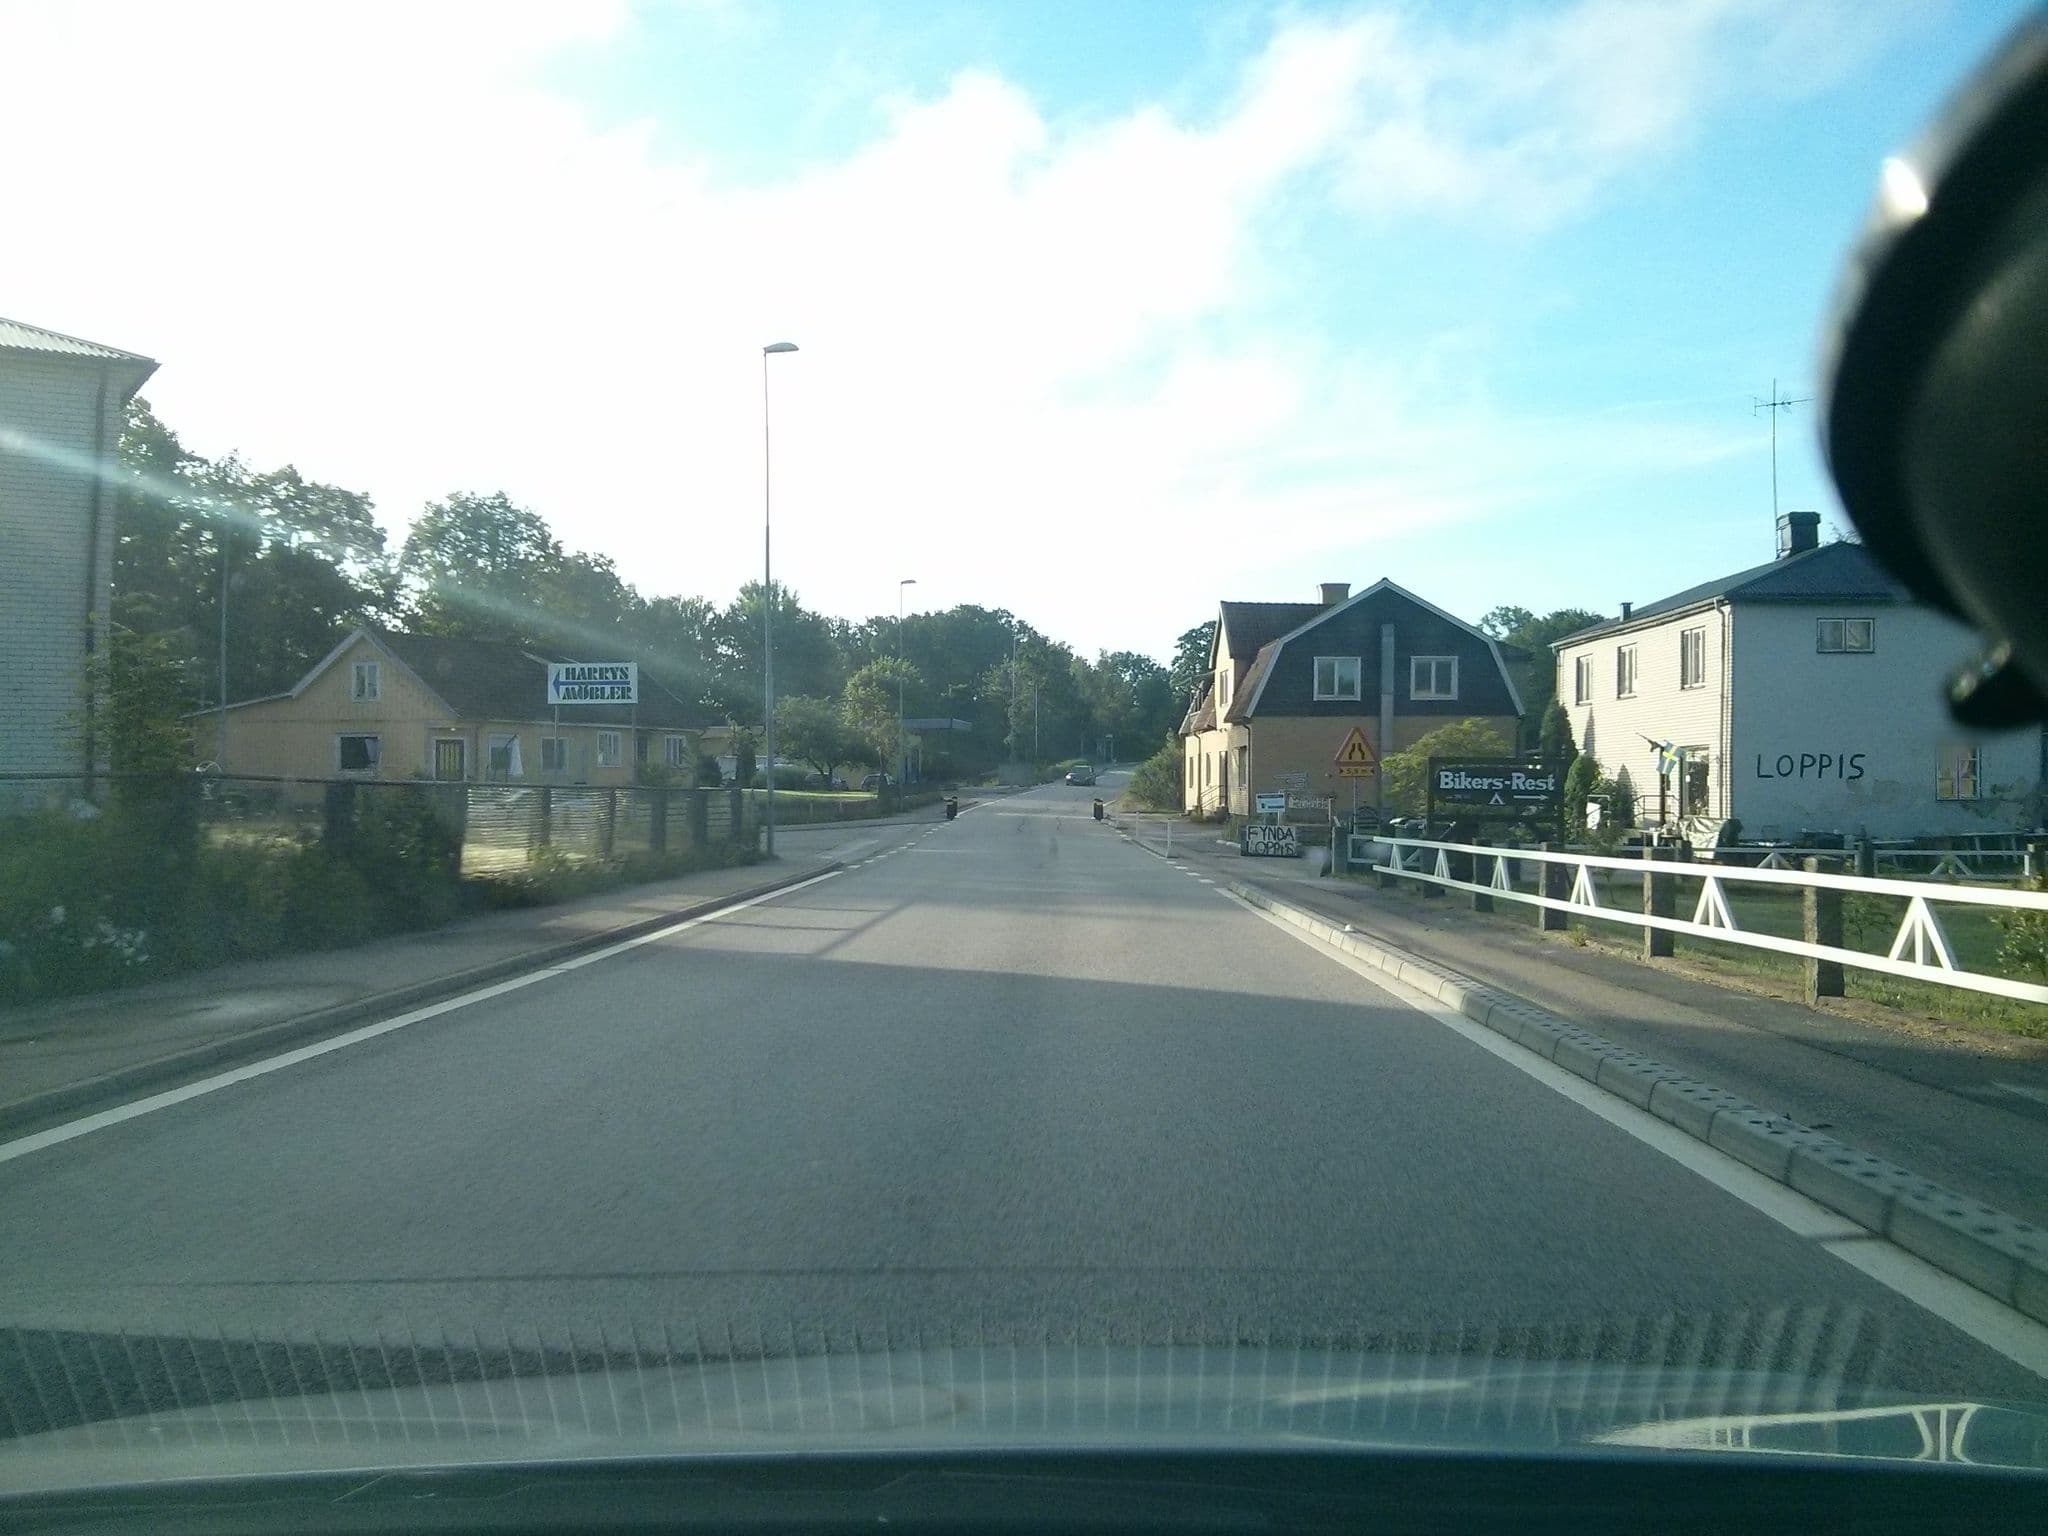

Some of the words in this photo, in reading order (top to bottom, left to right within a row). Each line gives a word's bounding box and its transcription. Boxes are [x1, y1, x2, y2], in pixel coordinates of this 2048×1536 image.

[565, 667, 629, 680] HARRYS
[562, 684, 632, 700] MÖBLER
[1757, 753, 1866, 779] LOPPIS
[1439, 771, 1555, 791] Bikers-Rest
[1247, 825, 1295, 841] FYNDA
[1246, 840, 1295, 856] LOPPIS
